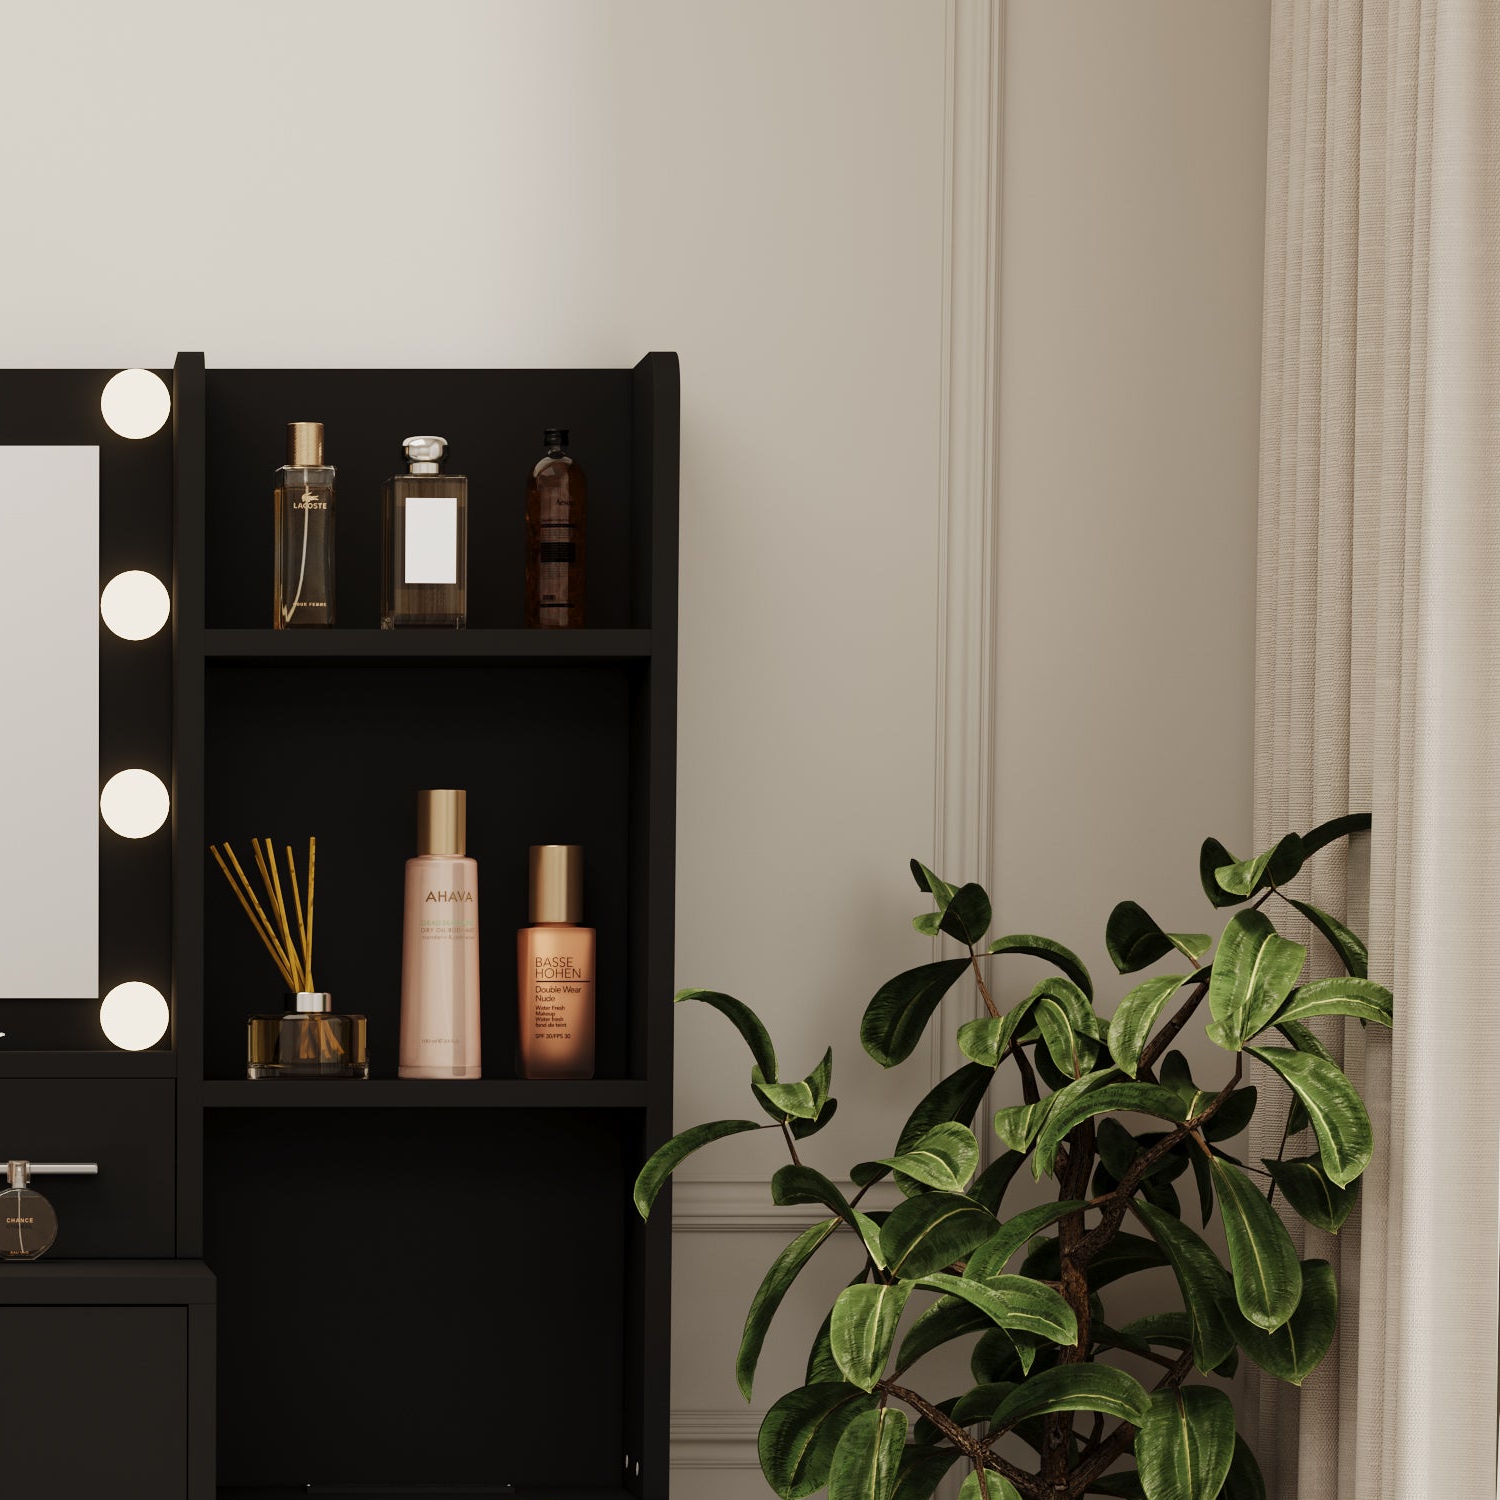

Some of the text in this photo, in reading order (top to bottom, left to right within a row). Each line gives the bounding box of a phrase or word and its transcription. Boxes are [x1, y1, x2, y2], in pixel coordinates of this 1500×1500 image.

[293, 502, 328, 510] LACOSTE
[425, 890, 473, 903] AHAVA
[535, 956, 574, 968] BASSE
[535, 968, 582, 979] HOHEN
[535, 985, 582, 994] Double Wear
[535, 994, 556, 1002] Nude
